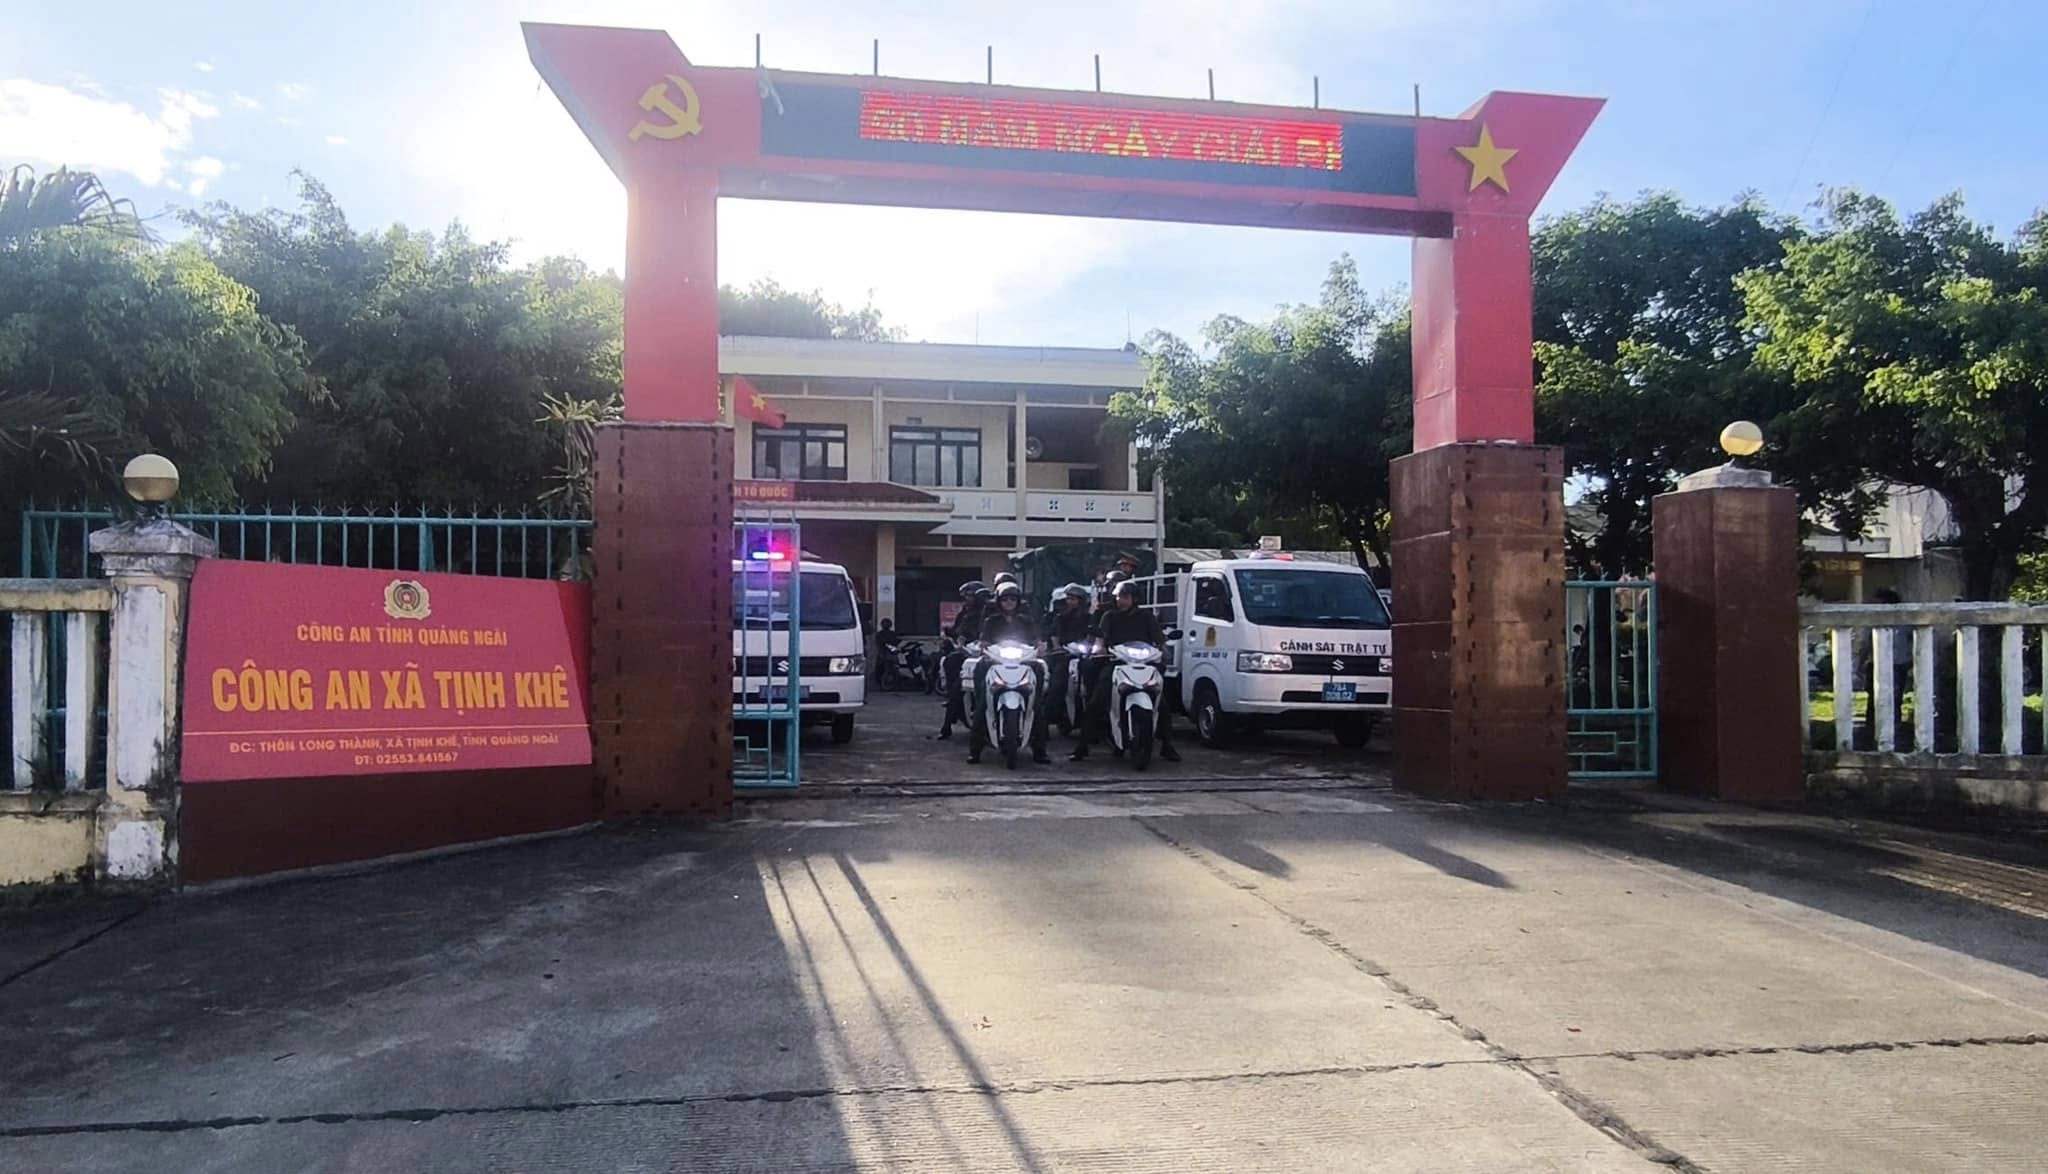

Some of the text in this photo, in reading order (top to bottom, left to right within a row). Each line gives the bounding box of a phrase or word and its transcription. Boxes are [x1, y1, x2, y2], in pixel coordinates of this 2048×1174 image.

[296, 621, 344, 642] CÔNG
[349, 626, 371, 643] AN
[376, 622, 414, 644] TỈNH
[418, 624, 469, 647] QUẢNG
[1280, 639, 1313, 652] CẢNH
[211, 658, 570, 716] CÔNG AN XÃ TỊNH KHÊ
[260, 737, 295, 753] THÔN
[298, 739, 336, 752] LONG
[490, 732, 529, 746] QUẢNG
